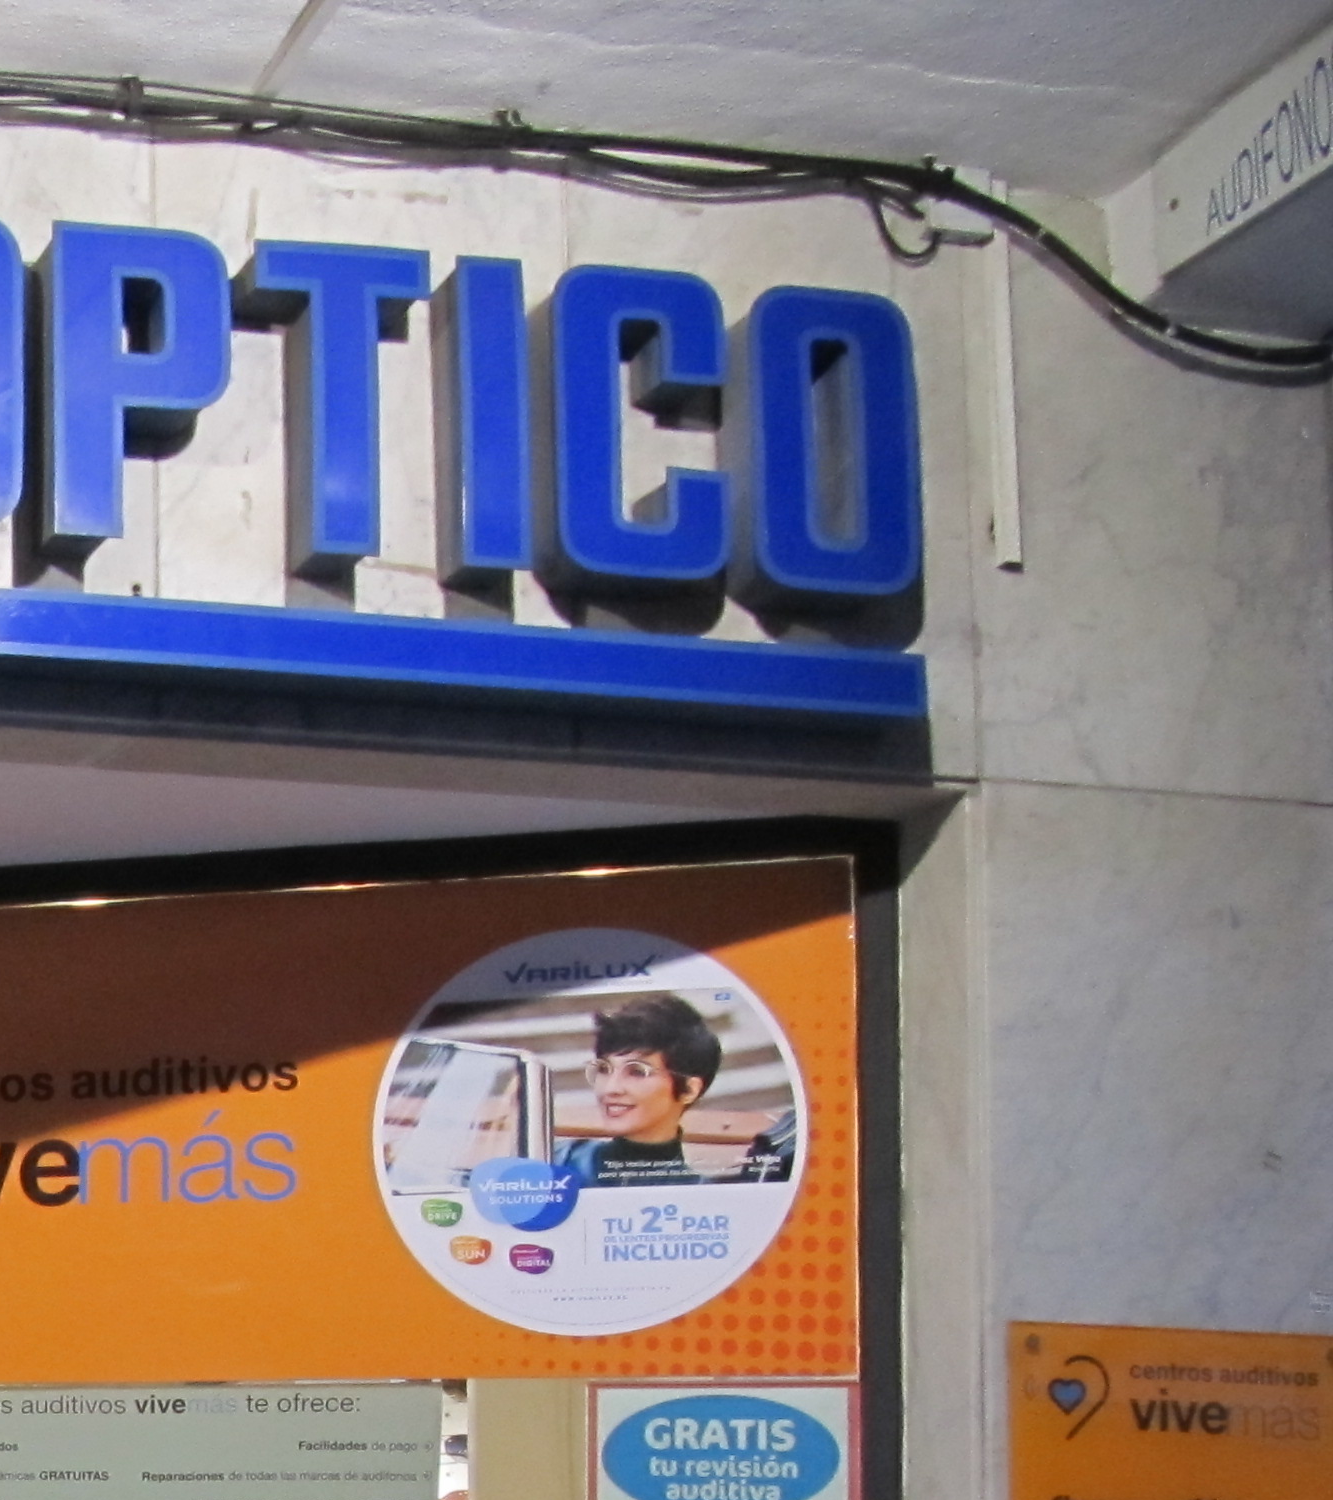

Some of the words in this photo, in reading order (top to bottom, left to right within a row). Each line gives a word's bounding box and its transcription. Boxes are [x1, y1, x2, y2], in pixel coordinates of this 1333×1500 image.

[1206, 45, 1333, 236] AUDIFONO
[72, 1057, 299, 1099] auditivos
[603, 1243, 729, 1262] INCLUIDO
[1129, 1363, 1213, 1383] centros
[1219, 1366, 1319, 1388] auditivos
[21, 1395, 127, 1415] auditivos
[246, 1395, 269, 1413] te
[277, 1393, 361, 1413] ofrece:
[644, 1418, 796, 1452] GRATIS
[650, 1457, 677, 1476] tu
[685, 1455, 798, 1478] revisión
